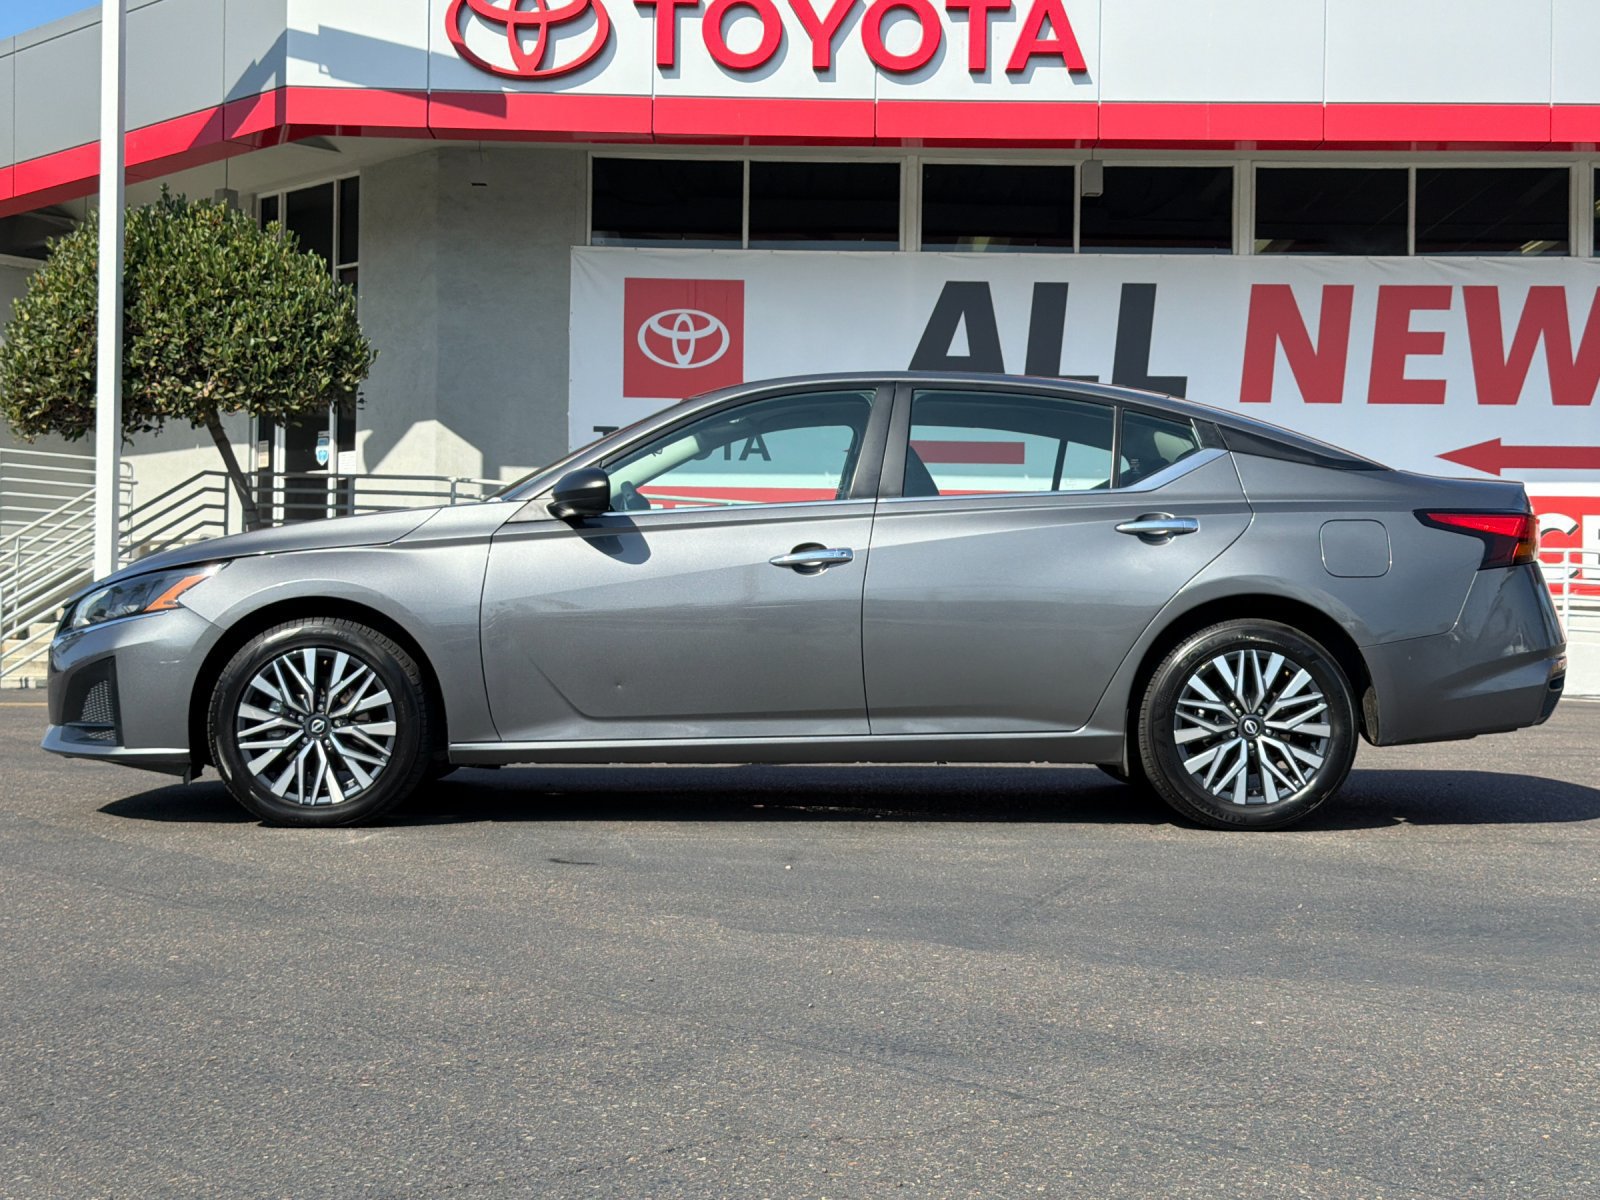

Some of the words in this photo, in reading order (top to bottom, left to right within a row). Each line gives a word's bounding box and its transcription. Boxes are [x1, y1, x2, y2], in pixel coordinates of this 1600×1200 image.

[634, 0, 1088, 74] TOYOTA
[907, 281, 1188, 400] ALL
[1240, 283, 1600, 406] NEW
